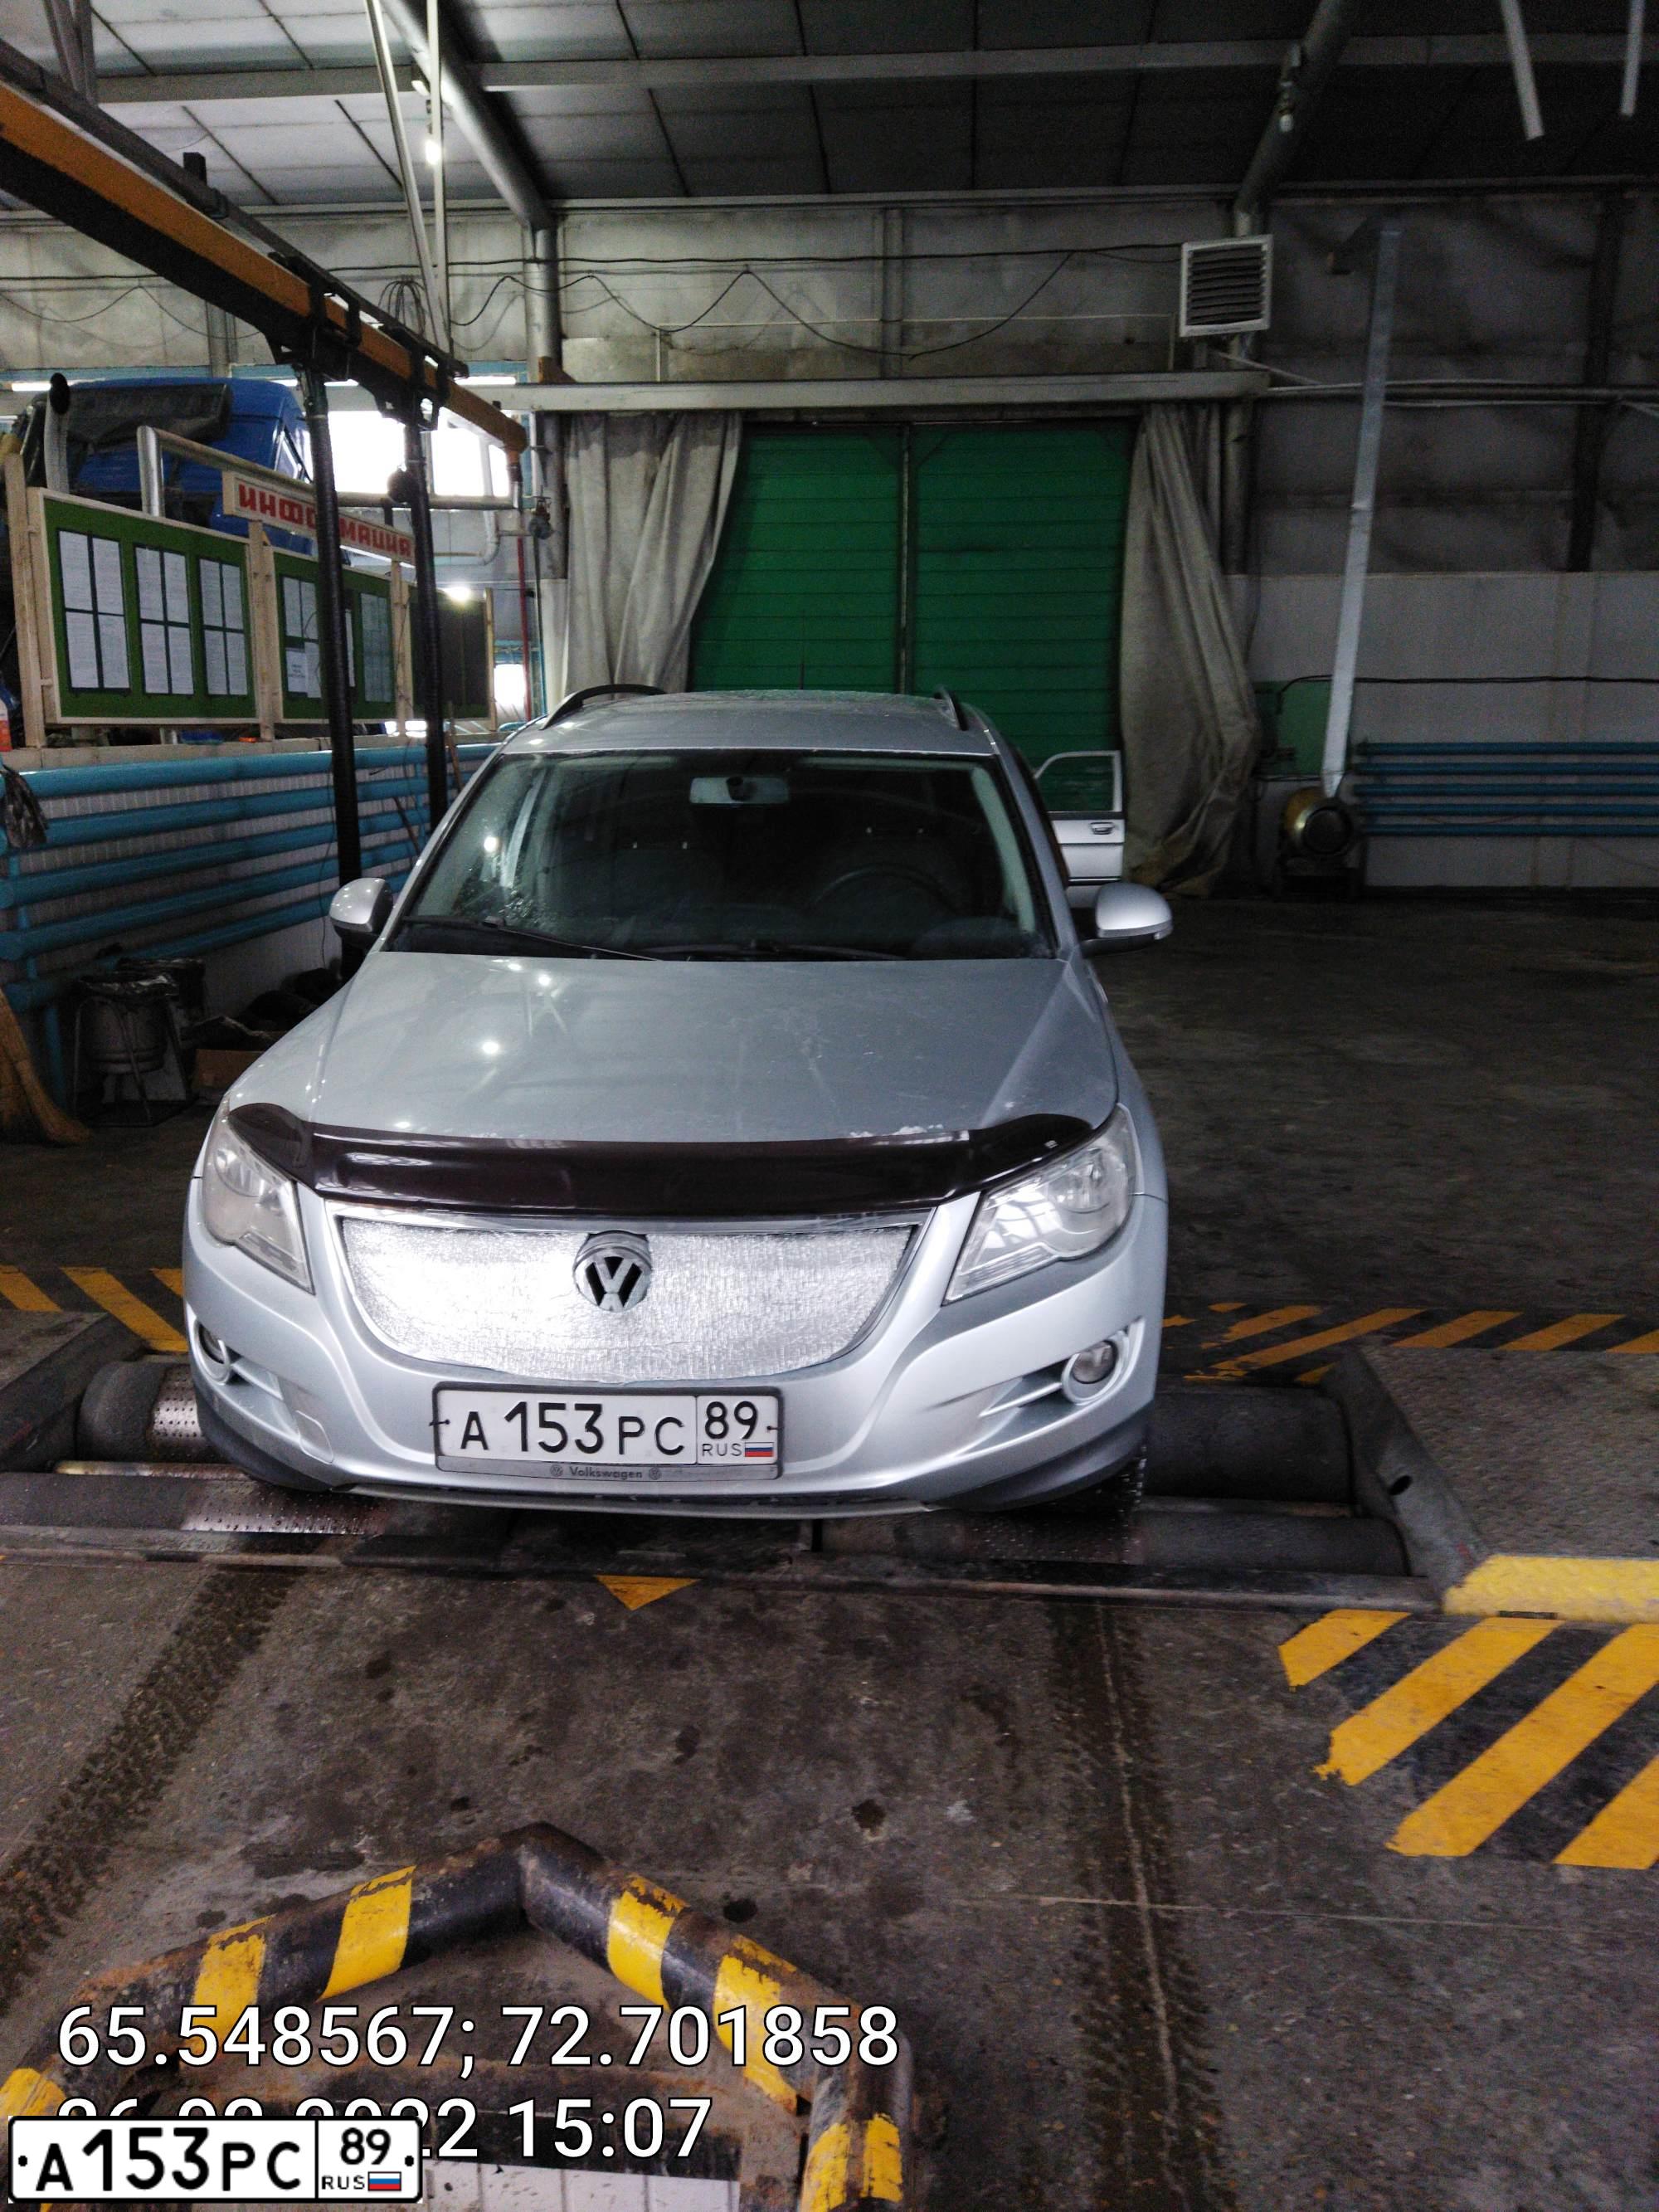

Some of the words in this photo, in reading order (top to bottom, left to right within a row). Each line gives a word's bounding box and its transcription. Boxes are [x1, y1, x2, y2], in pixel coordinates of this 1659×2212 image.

[238, 483, 411, 558] ИНФОМАЦИЯ
[704, 1401, 759, 1440] 89
[702, 1443, 742, 1457] RUS
[569, 1465, 643, 1480] Volkswagen
